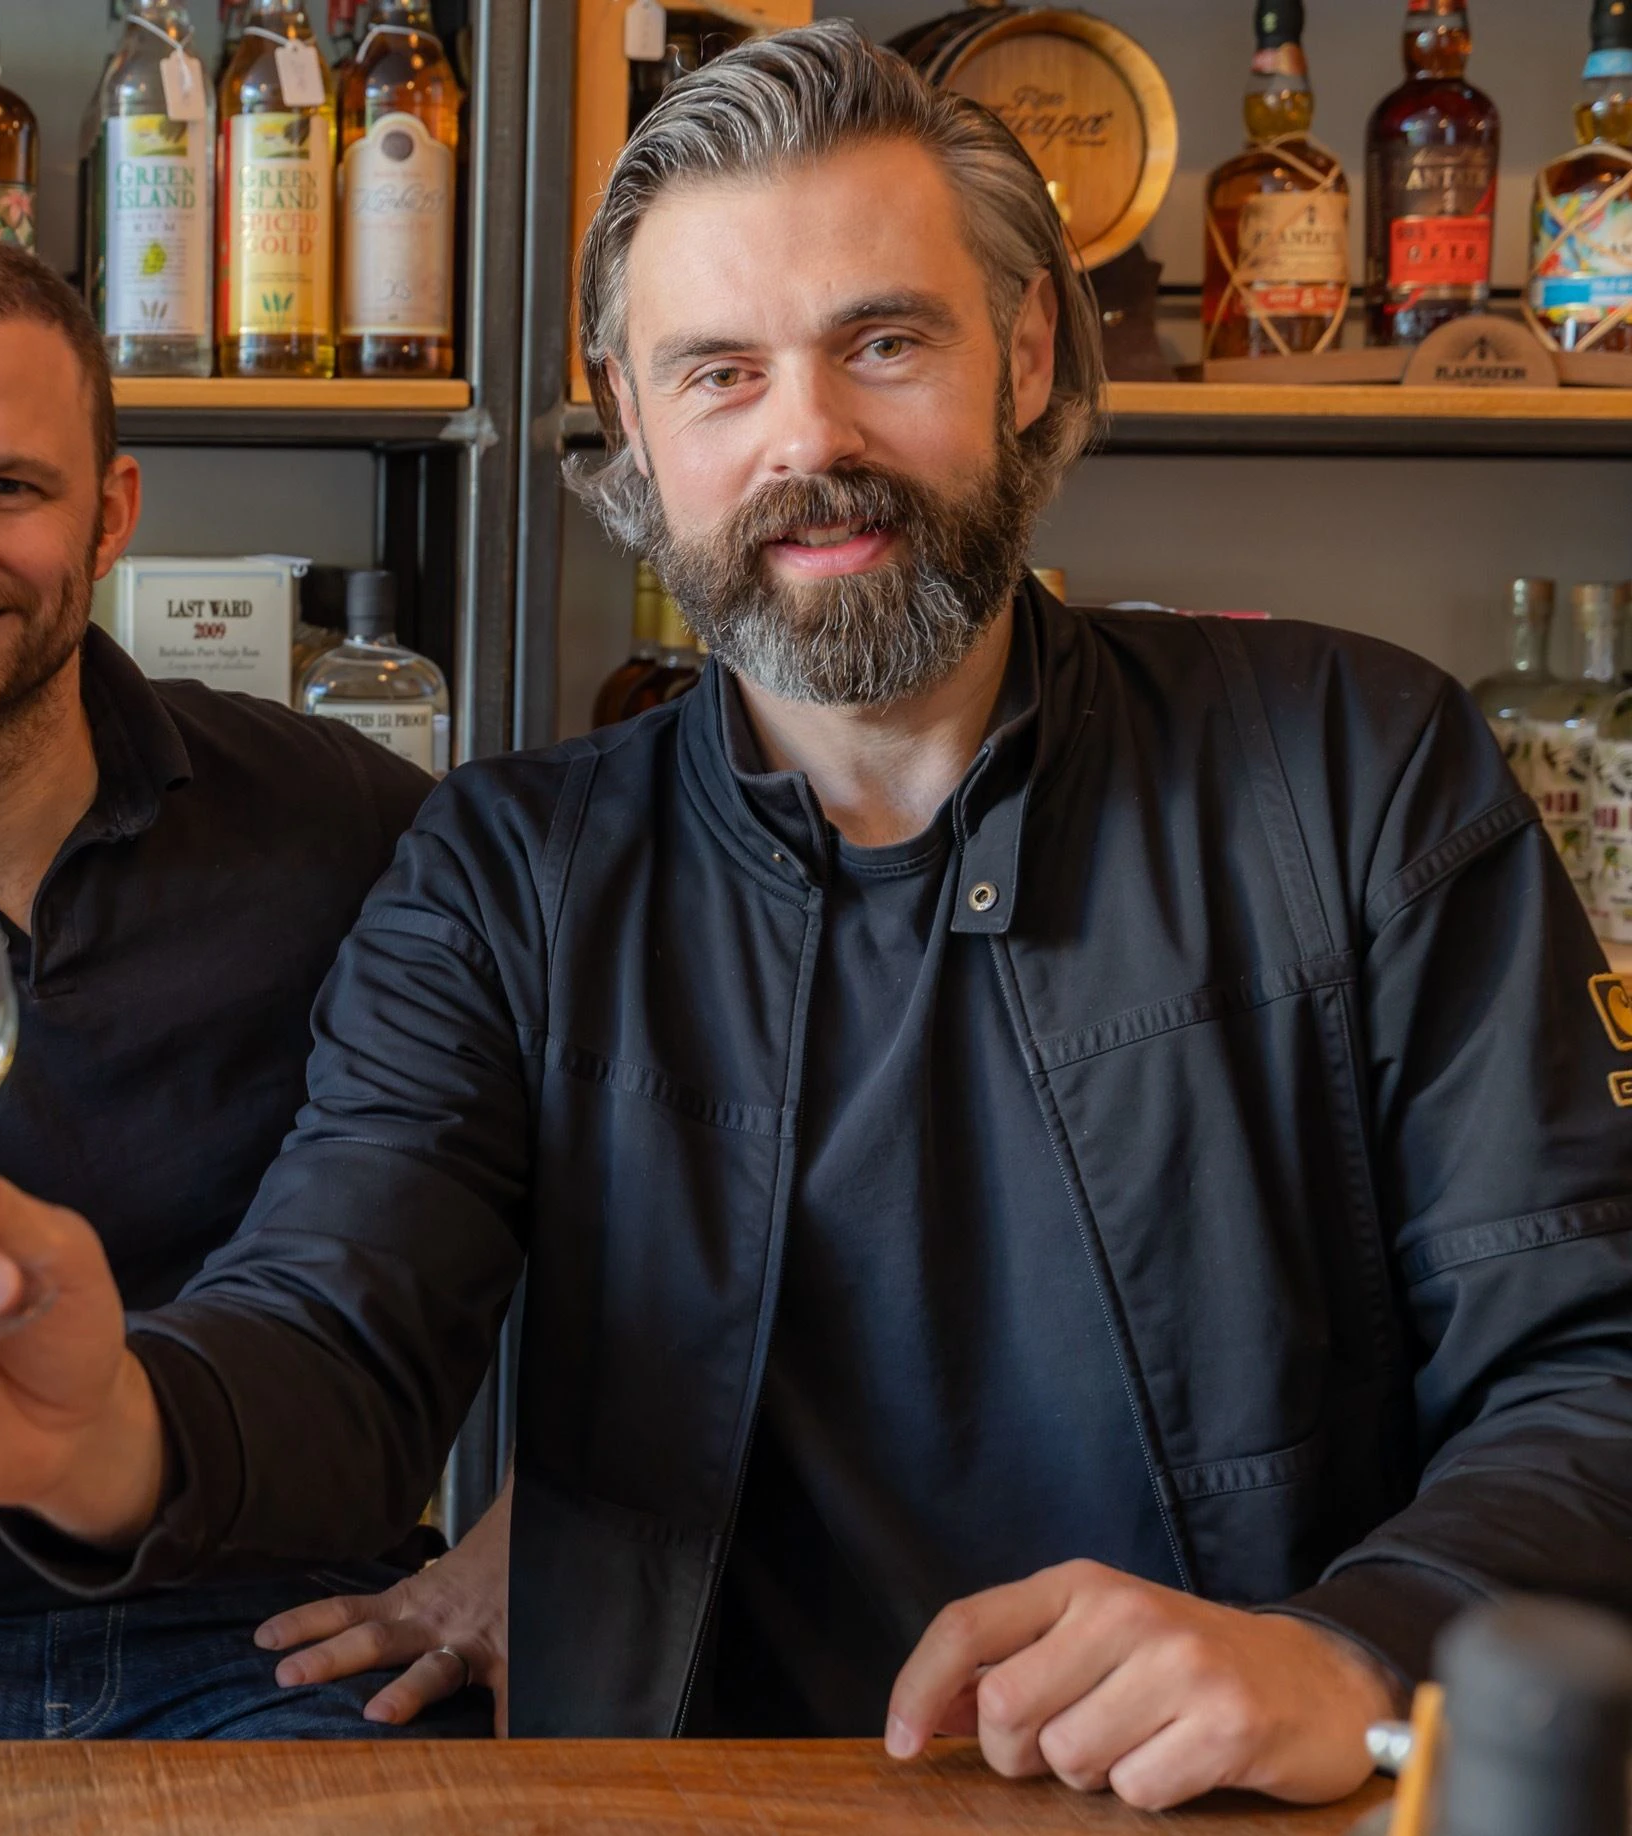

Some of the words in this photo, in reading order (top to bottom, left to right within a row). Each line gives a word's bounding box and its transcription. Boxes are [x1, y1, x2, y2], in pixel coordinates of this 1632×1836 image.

[115, 161, 197, 186] GREEN
[115, 187, 197, 209] ISLAND
[167, 600, 204, 618] LAST
[209, 600, 253, 618] WARD
[193, 621, 226, 640] 2009
